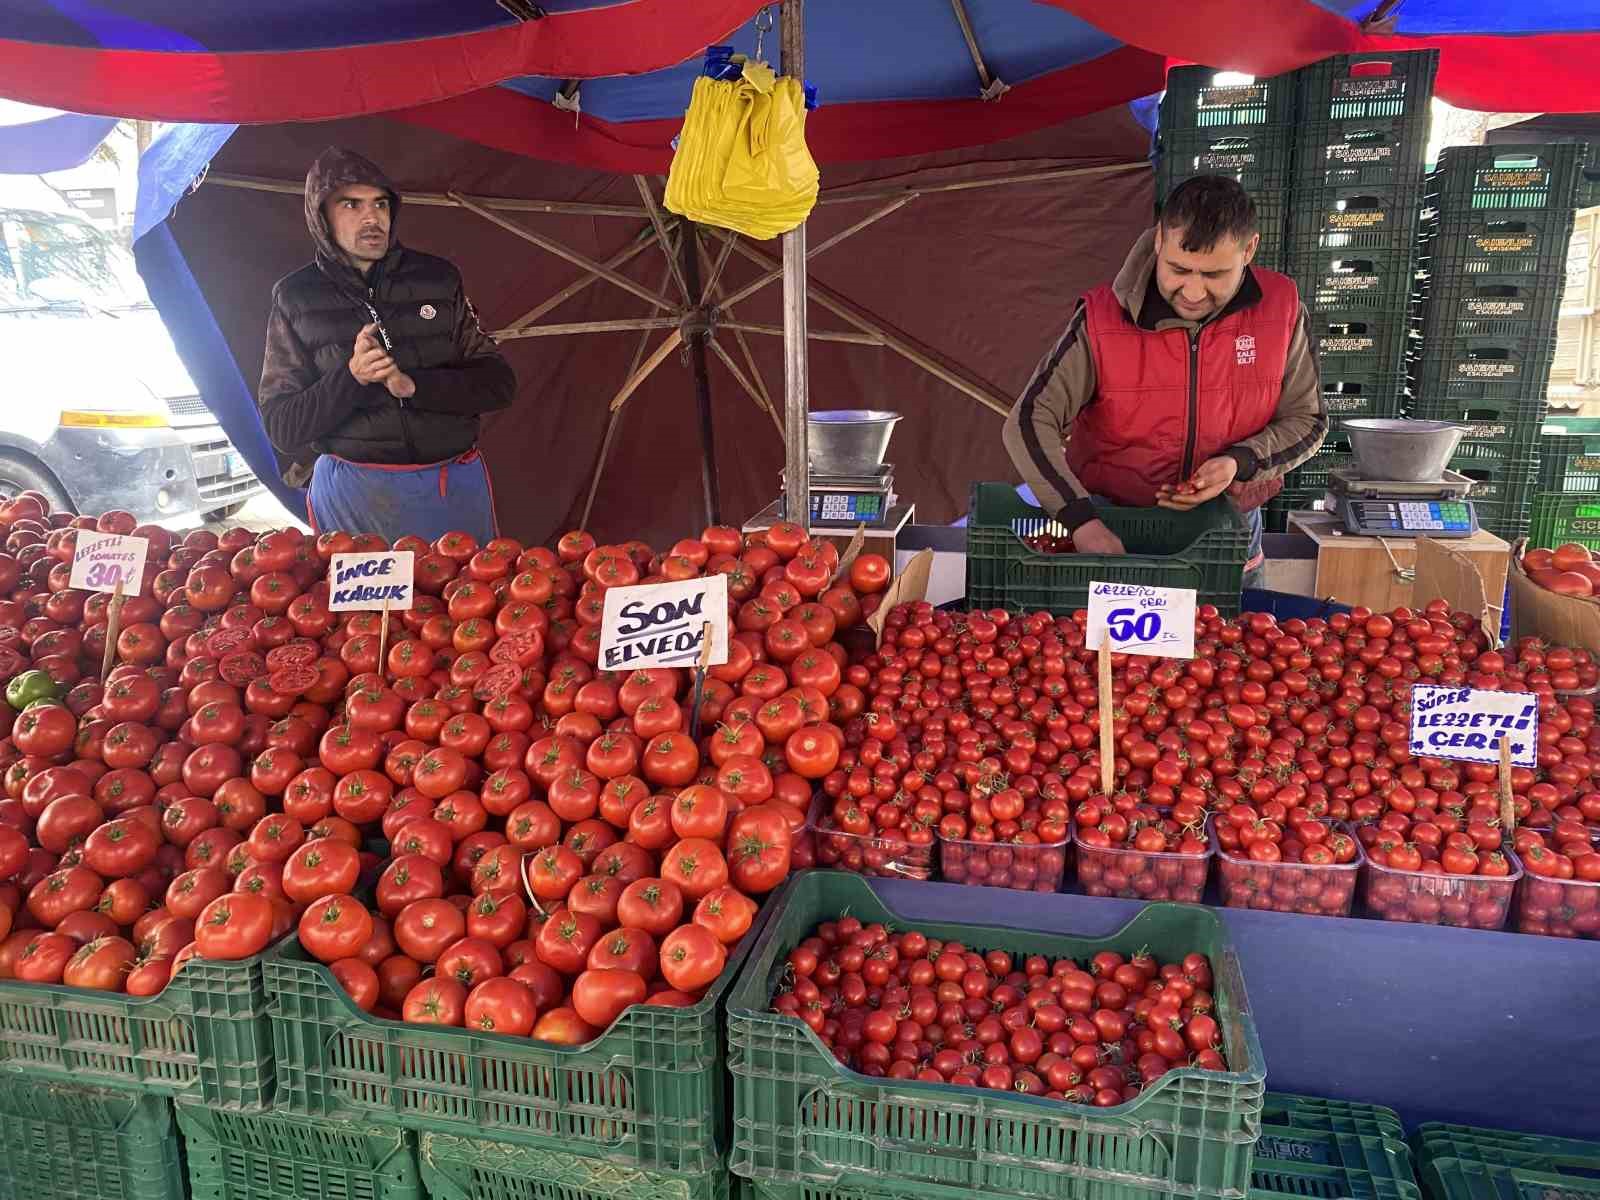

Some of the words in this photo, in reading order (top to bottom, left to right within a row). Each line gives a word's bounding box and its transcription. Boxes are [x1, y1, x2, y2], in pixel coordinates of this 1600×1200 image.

[332, 584, 409, 604] KABUK
[617, 591, 706, 635] SON
[1107, 608, 1161, 642] 50
[1417, 689, 1471, 712] SÜPER
